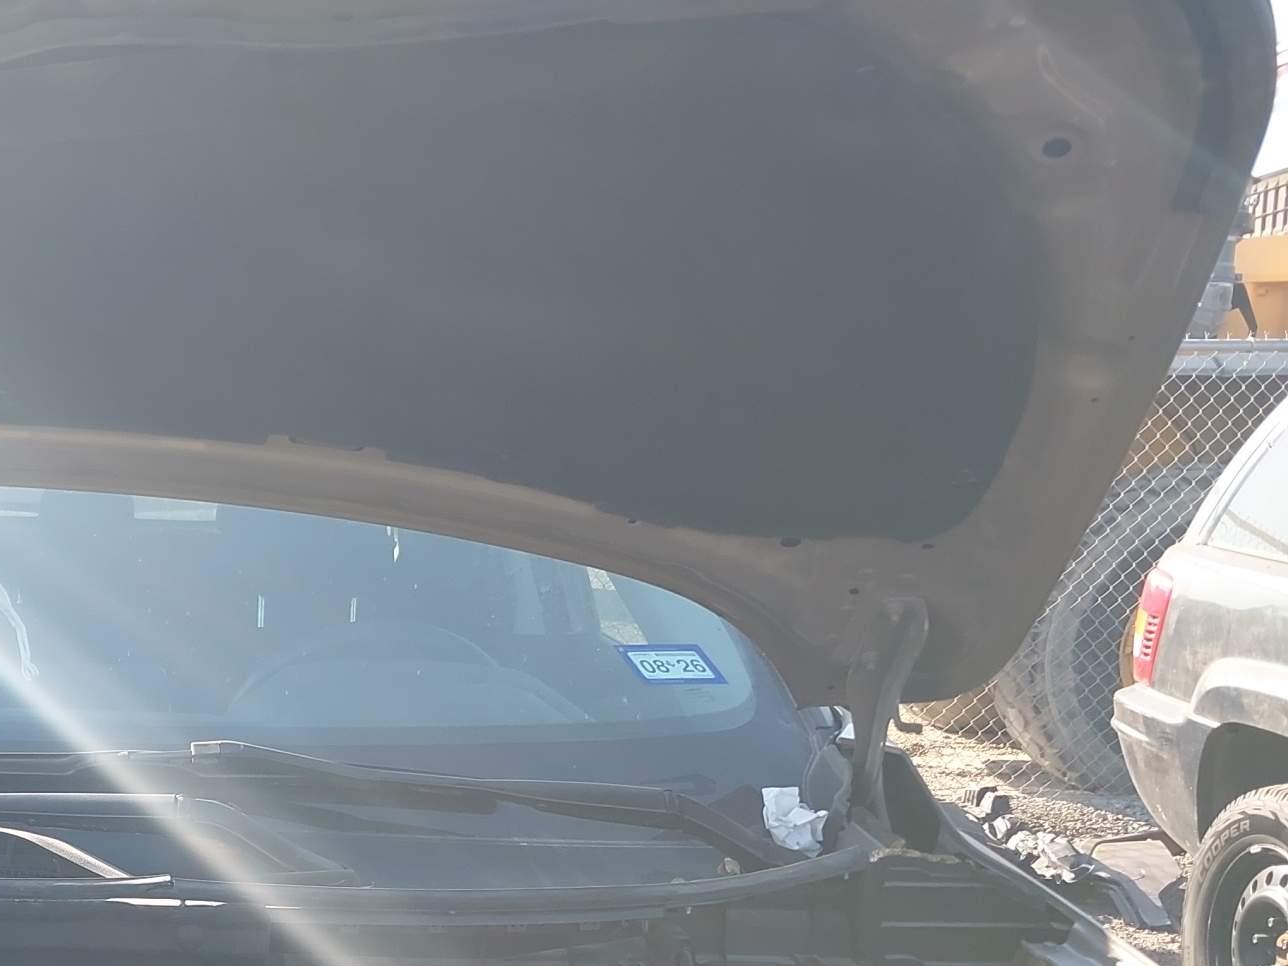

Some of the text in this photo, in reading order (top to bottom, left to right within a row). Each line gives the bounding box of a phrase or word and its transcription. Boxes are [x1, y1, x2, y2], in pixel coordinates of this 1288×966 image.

[639, 659, 707, 674] 08 26
[1198, 819, 1250, 881] COOPER
